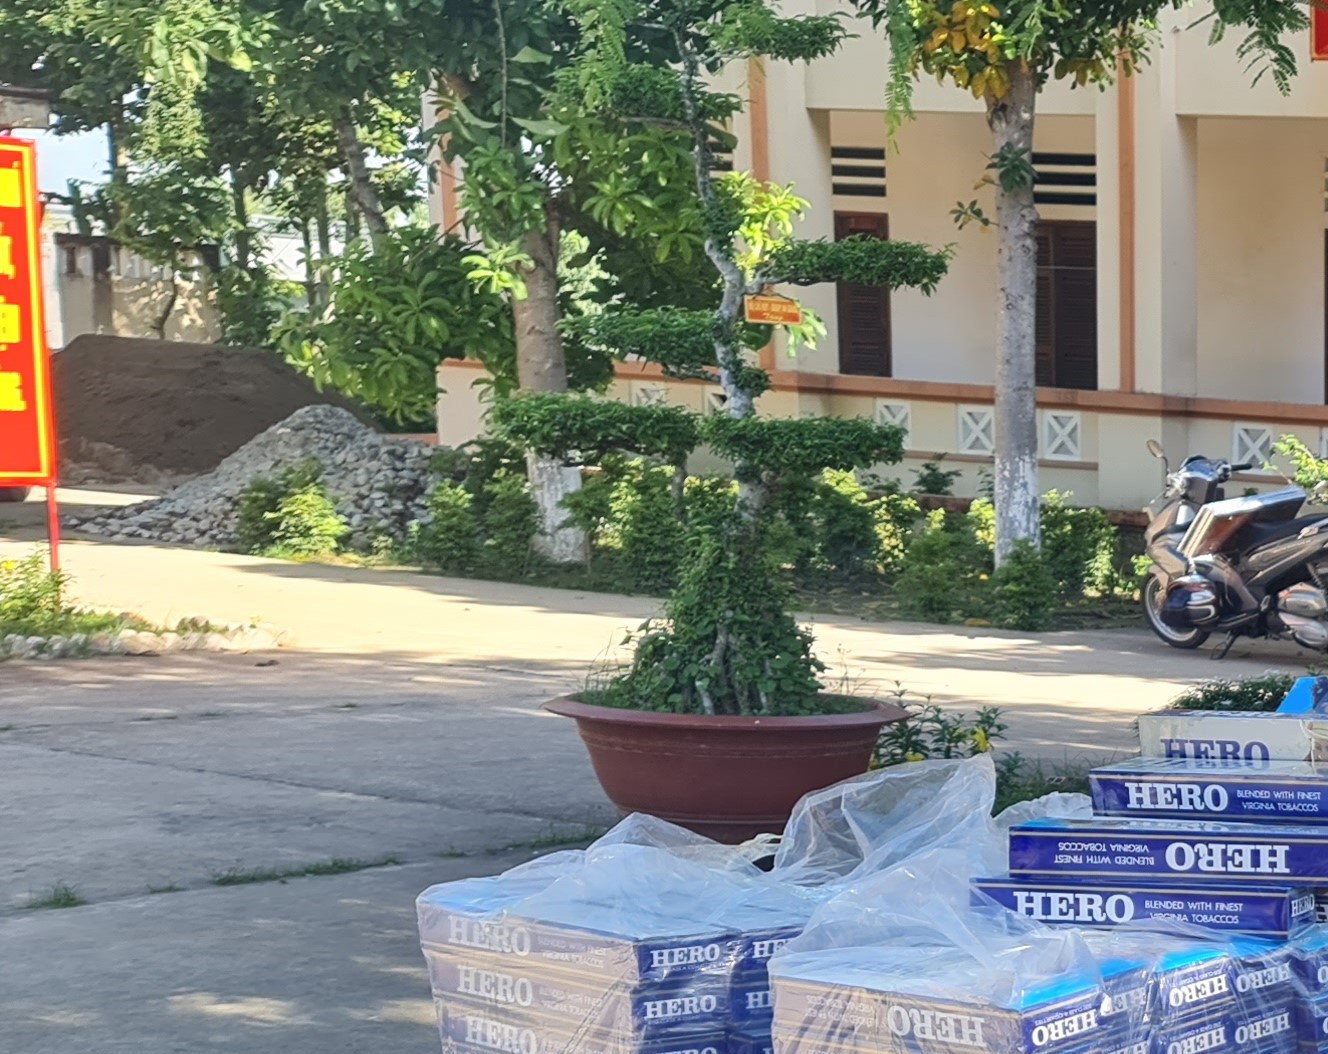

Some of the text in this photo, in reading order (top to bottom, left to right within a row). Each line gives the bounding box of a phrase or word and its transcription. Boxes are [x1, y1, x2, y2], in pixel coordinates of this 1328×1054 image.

[1161, 739, 1271, 770] HERO
[1125, 782, 1229, 812] HERO
[1236, 790, 1321, 800] BLENDED WITH FINEST
[1242, 802, 1275, 810] VIRGINIA
[1054, 854, 1154, 865] BLENDED WITH FINEST
[1110, 843, 1149, 852] VIRGINIA
[1165, 841, 1290, 873] HERO
[1013, 891, 1134, 923] HERO
[1145, 900, 1243, 912] BLENDED WITH FINEST
[1291, 894, 1315, 917] HERO
[448, 915, 531, 957] HERO
[650, 943, 720, 968] HERO
[457, 966, 533, 1007] HERO
[1170, 974, 1228, 1007] HERO
[644, 995, 717, 1021] HERO
[888, 1005, 987, 1048] HERO
[1032, 1009, 1097, 1046] HERO
